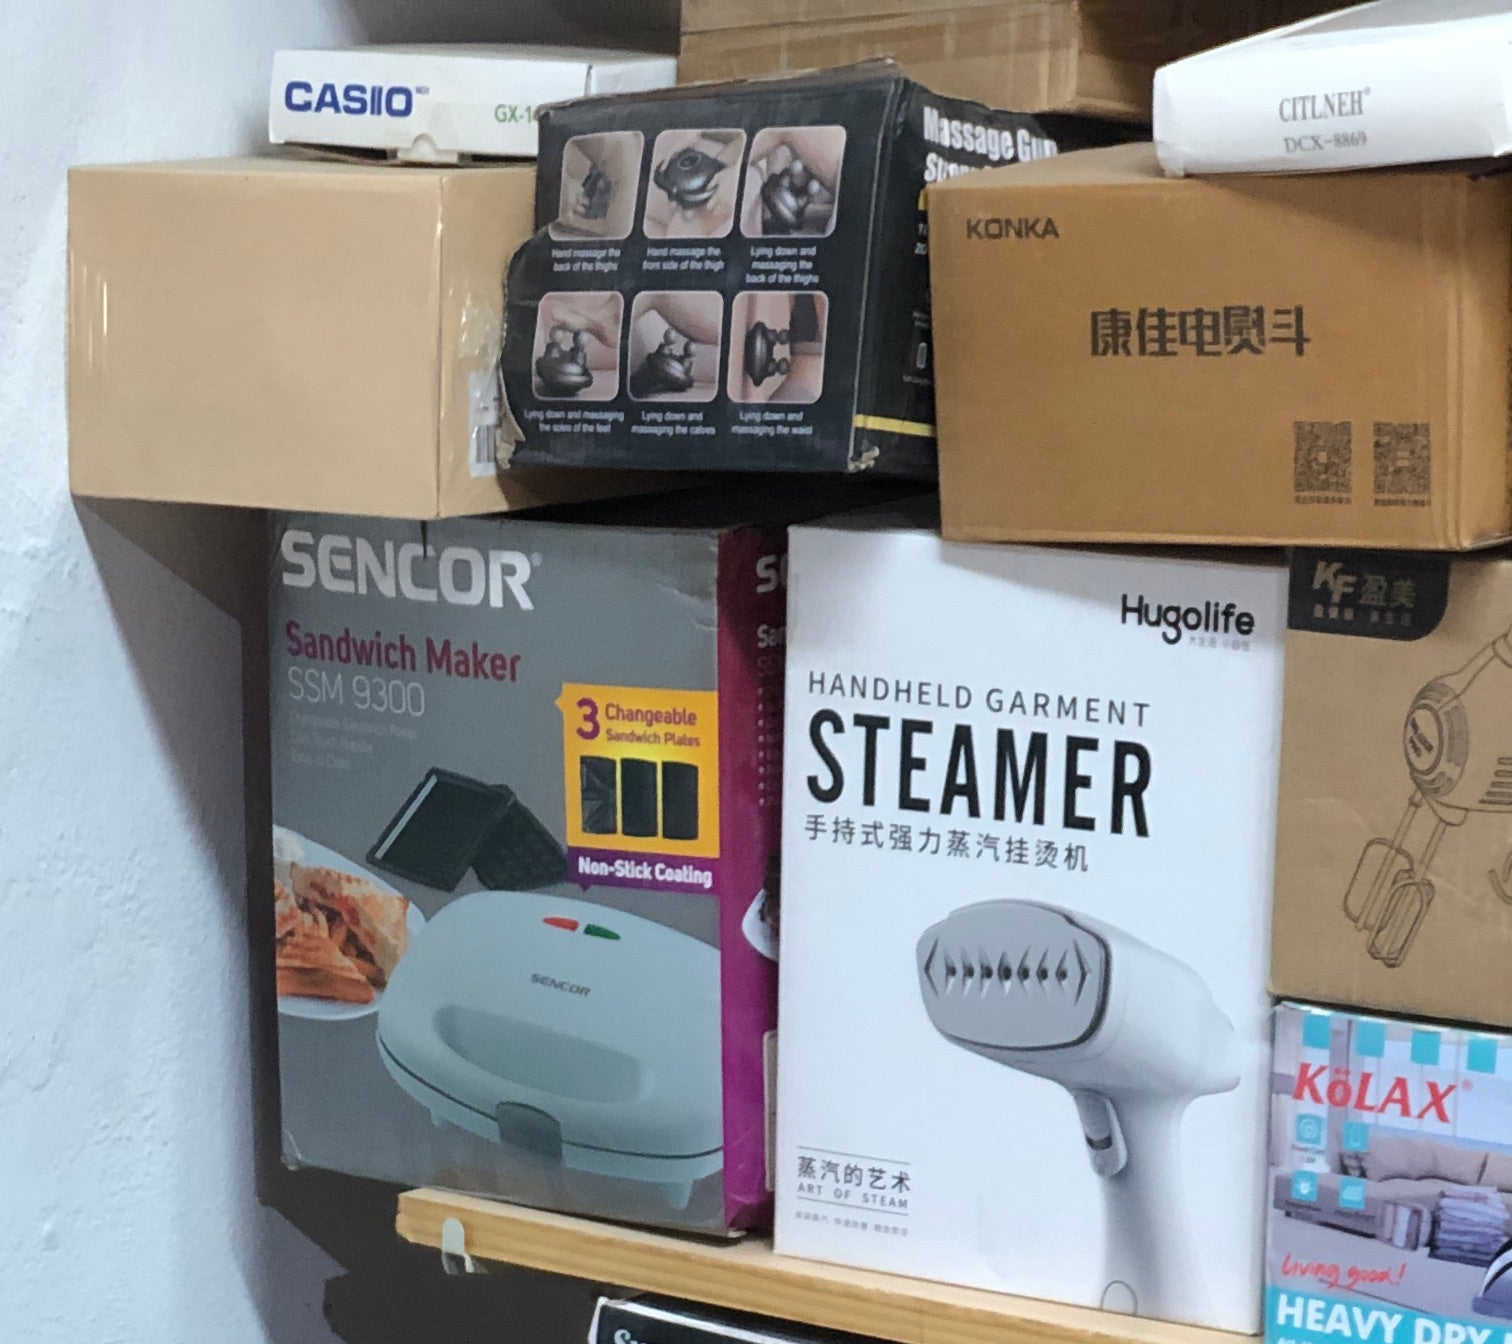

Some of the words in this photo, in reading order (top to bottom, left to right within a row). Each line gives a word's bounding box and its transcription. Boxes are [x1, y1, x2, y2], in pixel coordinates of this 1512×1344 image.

[494, 103, 540, 124] GX-1
[1279, 90, 1364, 122] CITLNEH
[923, 106, 1015, 161] Massage
[966, 217, 1059, 239] KONKA
[1091, 305, 1311, 357] 康佳电熨斗
[281, 529, 534, 611] SENCOR
[1121, 593, 1255, 645] Hugolife
[285, 619, 417, 673] Sandwich
[427, 639, 521, 683] Maker
[288, 666, 343, 702] SSM
[352, 674, 426, 717] 9300
[807, 670, 973, 709] HANDHELD
[985, 687, 1150, 728] GARMENT
[576, 698, 600, 740] 3
[605, 702, 697, 728] Changeable
[606, 728, 661, 746] Sandwich
[664, 732, 701, 748] Plates
[806, 708, 1152, 838] STEAMER
[579, 856, 652, 882] Non-Stick
[655, 863, 713, 888] Coating
[530, 973, 591, 997] SENCOR
[797, 1156, 910, 1193] 蒸汽的艺术
[798, 1182, 823, 1195] ART
[833, 1188, 851, 1200] OF
[862, 1193, 908, 1209] STEAM
[1277, 1293, 1402, 1344] HEAVY
